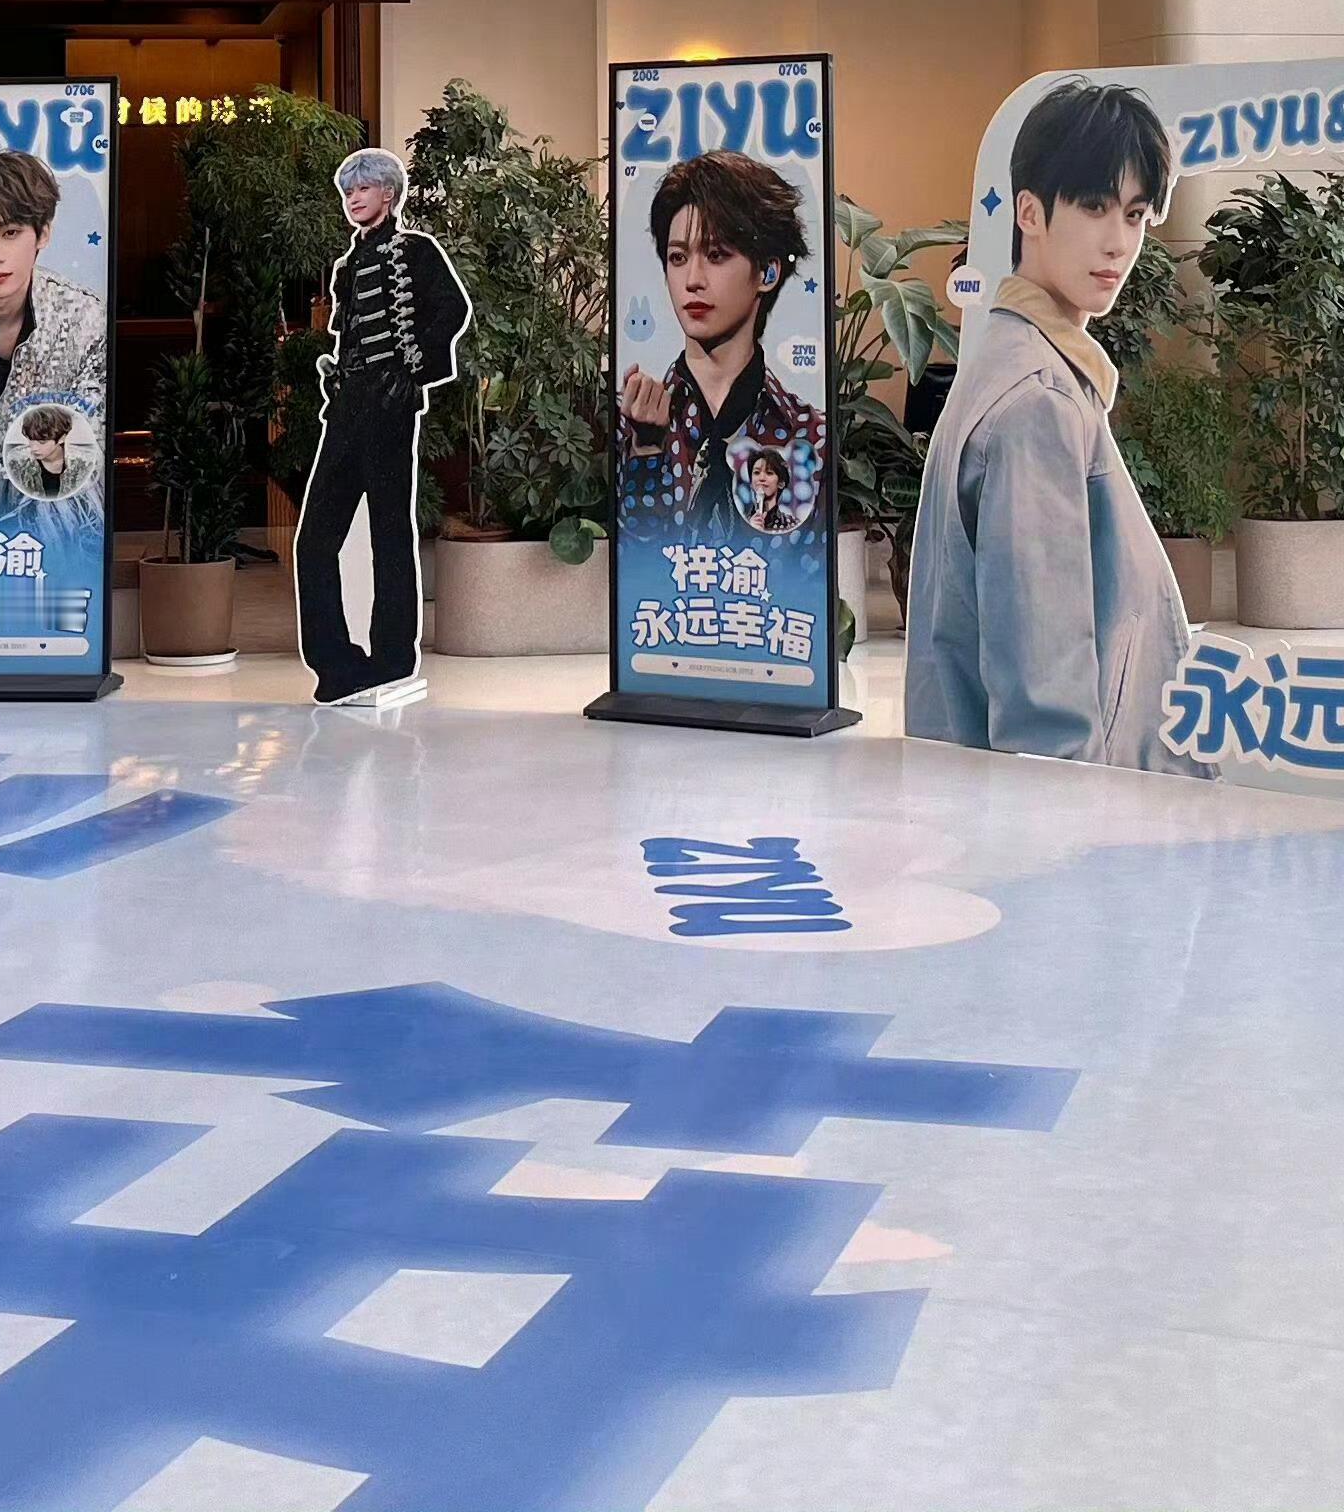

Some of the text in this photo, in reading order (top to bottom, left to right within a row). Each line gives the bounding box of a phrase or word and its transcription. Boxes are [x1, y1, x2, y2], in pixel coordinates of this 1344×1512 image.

[633, 63, 808, 81] 2002 0706
[65, 85, 95, 96] 0706
[621, 78, 821, 163] ZIYU
[808, 122, 822, 133] 06
[95, 139, 109, 149] 06
[624, 166, 637, 177] 07
[954, 280, 980, 292] YUNI
[792, 344, 816, 355] ZIYU
[792, 355, 816, 366] 0706
[670, 544, 769, 596] 梓渝
[630, 596, 816, 662] 永远幸福
[640, 836, 853, 937] ZIYU
